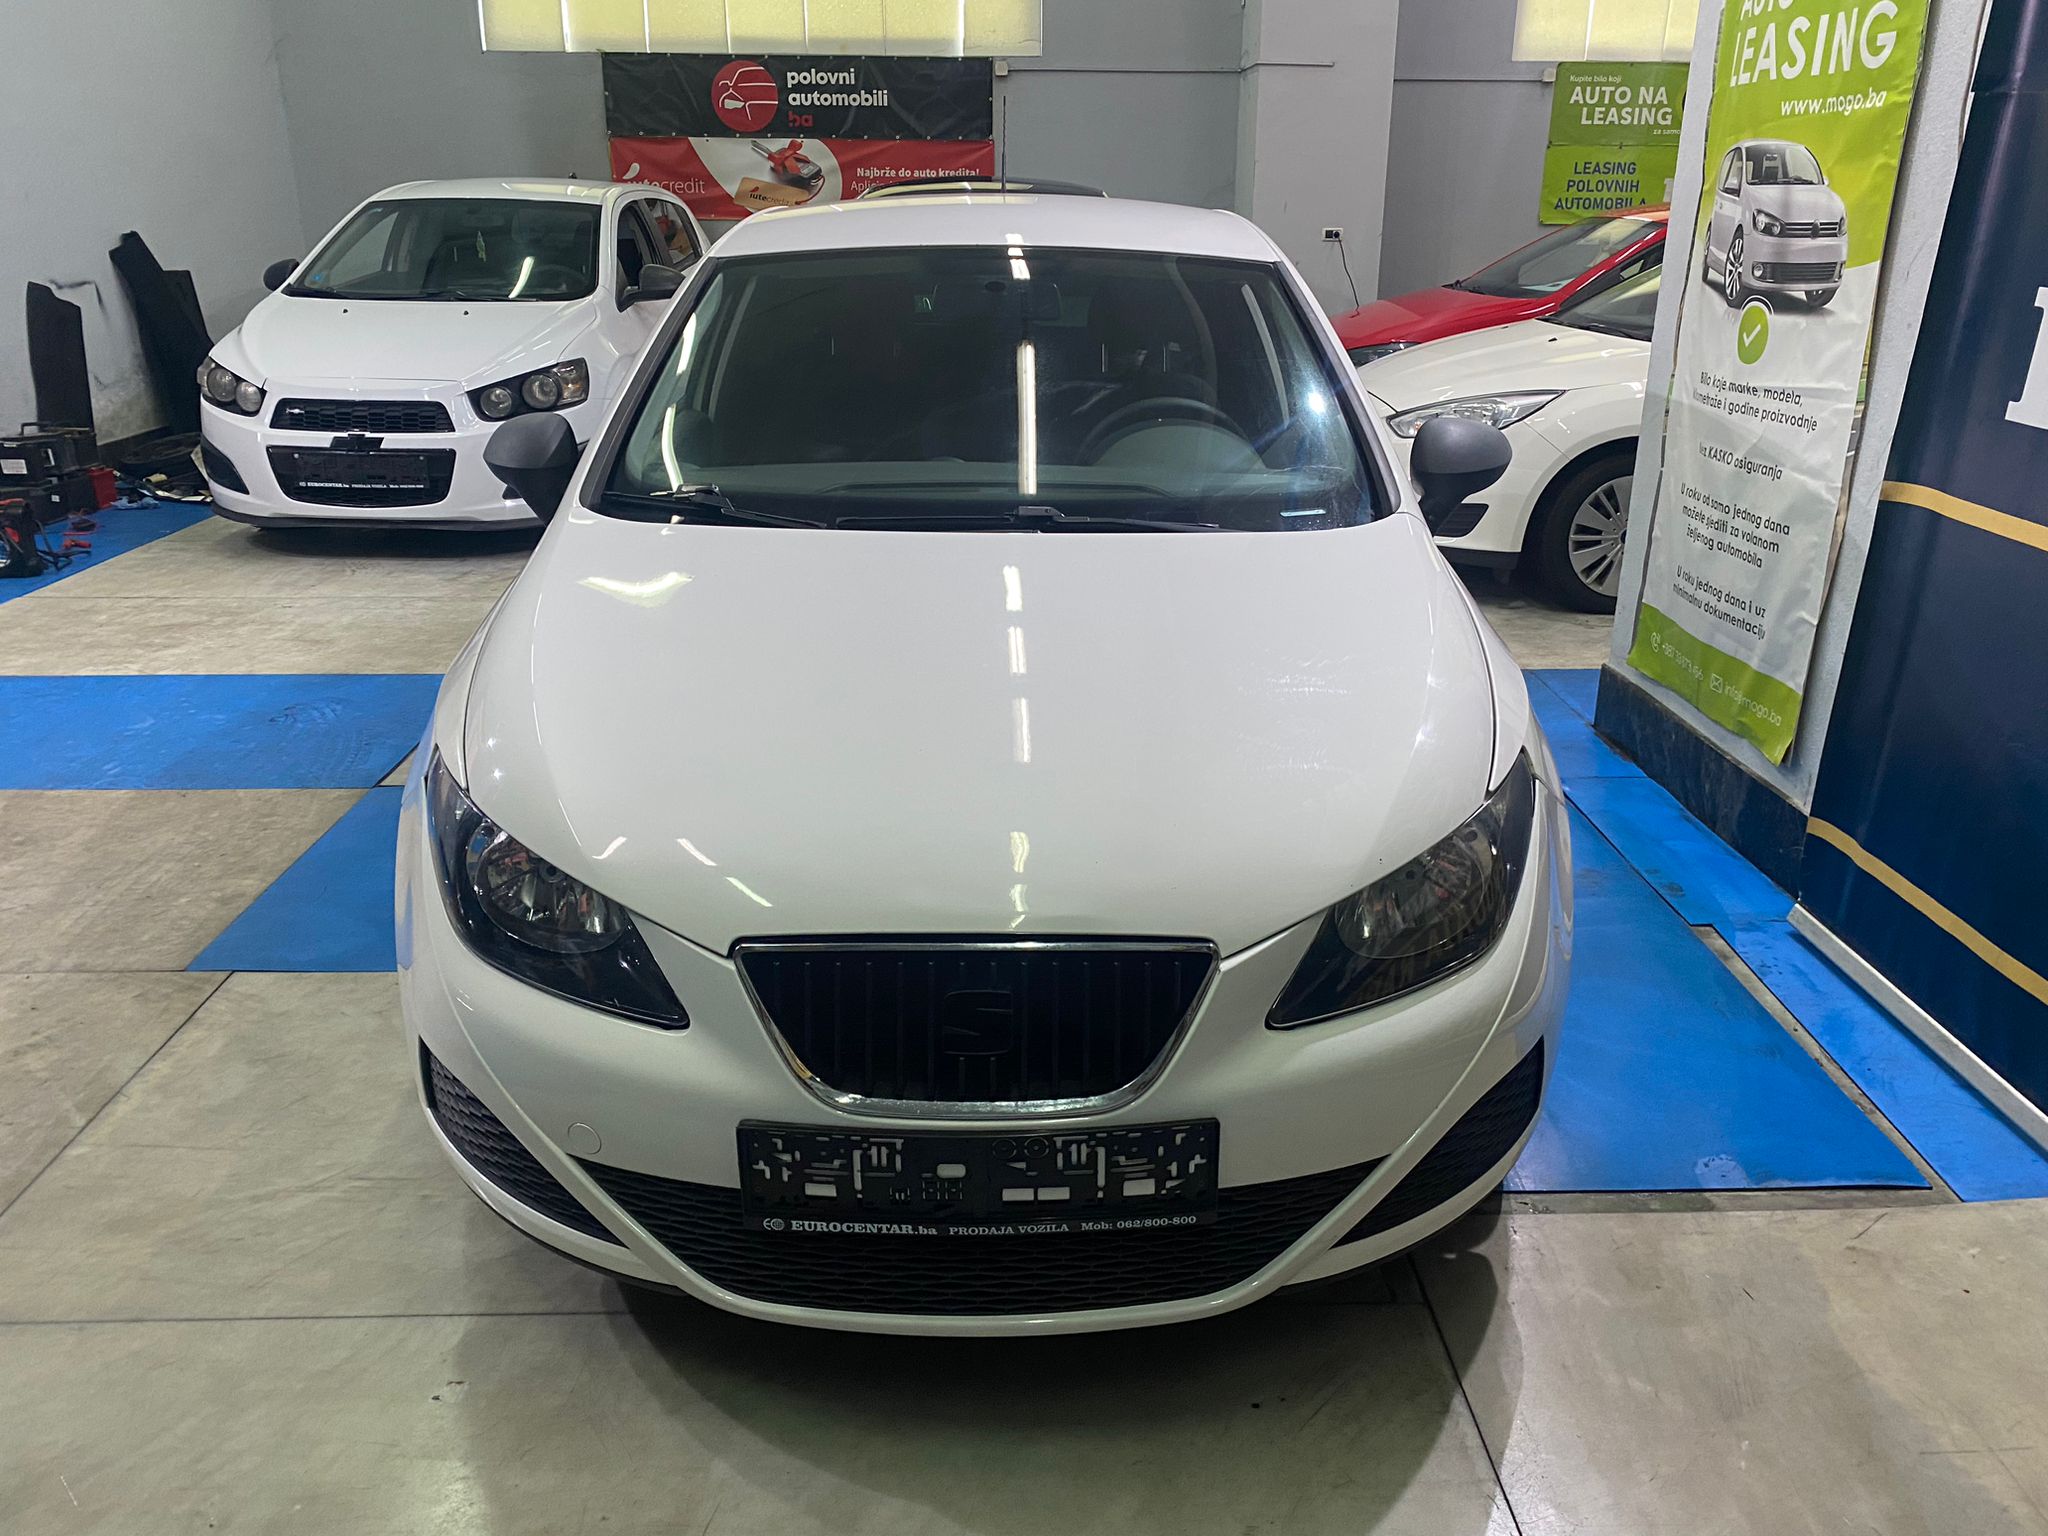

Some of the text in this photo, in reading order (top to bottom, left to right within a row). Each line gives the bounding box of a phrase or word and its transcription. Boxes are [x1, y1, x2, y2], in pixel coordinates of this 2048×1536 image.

[1730, 0, 1898, 87] LEASING
[786, 67, 855, 88] polovni
[788, 89, 888, 106] automobili
[1569, 86, 1668, 105] AUTO NA
[1780, 87, 1887, 116] www.mogo.ba
[1580, 107, 1673, 125] LEASING
[856, 167, 896, 179] Najbrže
[898, 168, 911, 177] do
[913, 168, 937, 177] auto
[1574, 162, 1637, 175] LEASING
[1566, 180, 1640, 193] POLOVNIH
[1728, 381, 1760, 399] marke,
[1763, 388, 1803, 407] modela,
[1728, 400, 1759, 418] godine
[1760, 409, 1817, 433] proizvodnje
[1707, 445, 1734, 466] KASKO
[1733, 456, 1783, 482] osiguranja
[1685, 486, 1701, 501] roku
[1702, 493, 1710, 506] od
[1711, 498, 1731, 515] samo
[1732, 504, 1762, 529] jednog
[1763, 516, 1790, 536] dana
[1682, 504, 1780, 553] možete sjediti za volanom
[1716, 540, 1762, 568] automobila
[1695, 576, 1722, 602] jednog
[1724, 591, 1747, 611] dana
[1755, 605, 1766, 618] uz
[1673, 583, 1766, 641] minimalnu dokumentaciju
[791, 1215, 1197, 1236] EUROCENTAR.ba PRODAJA VOZILA Mob: 062/800-800
